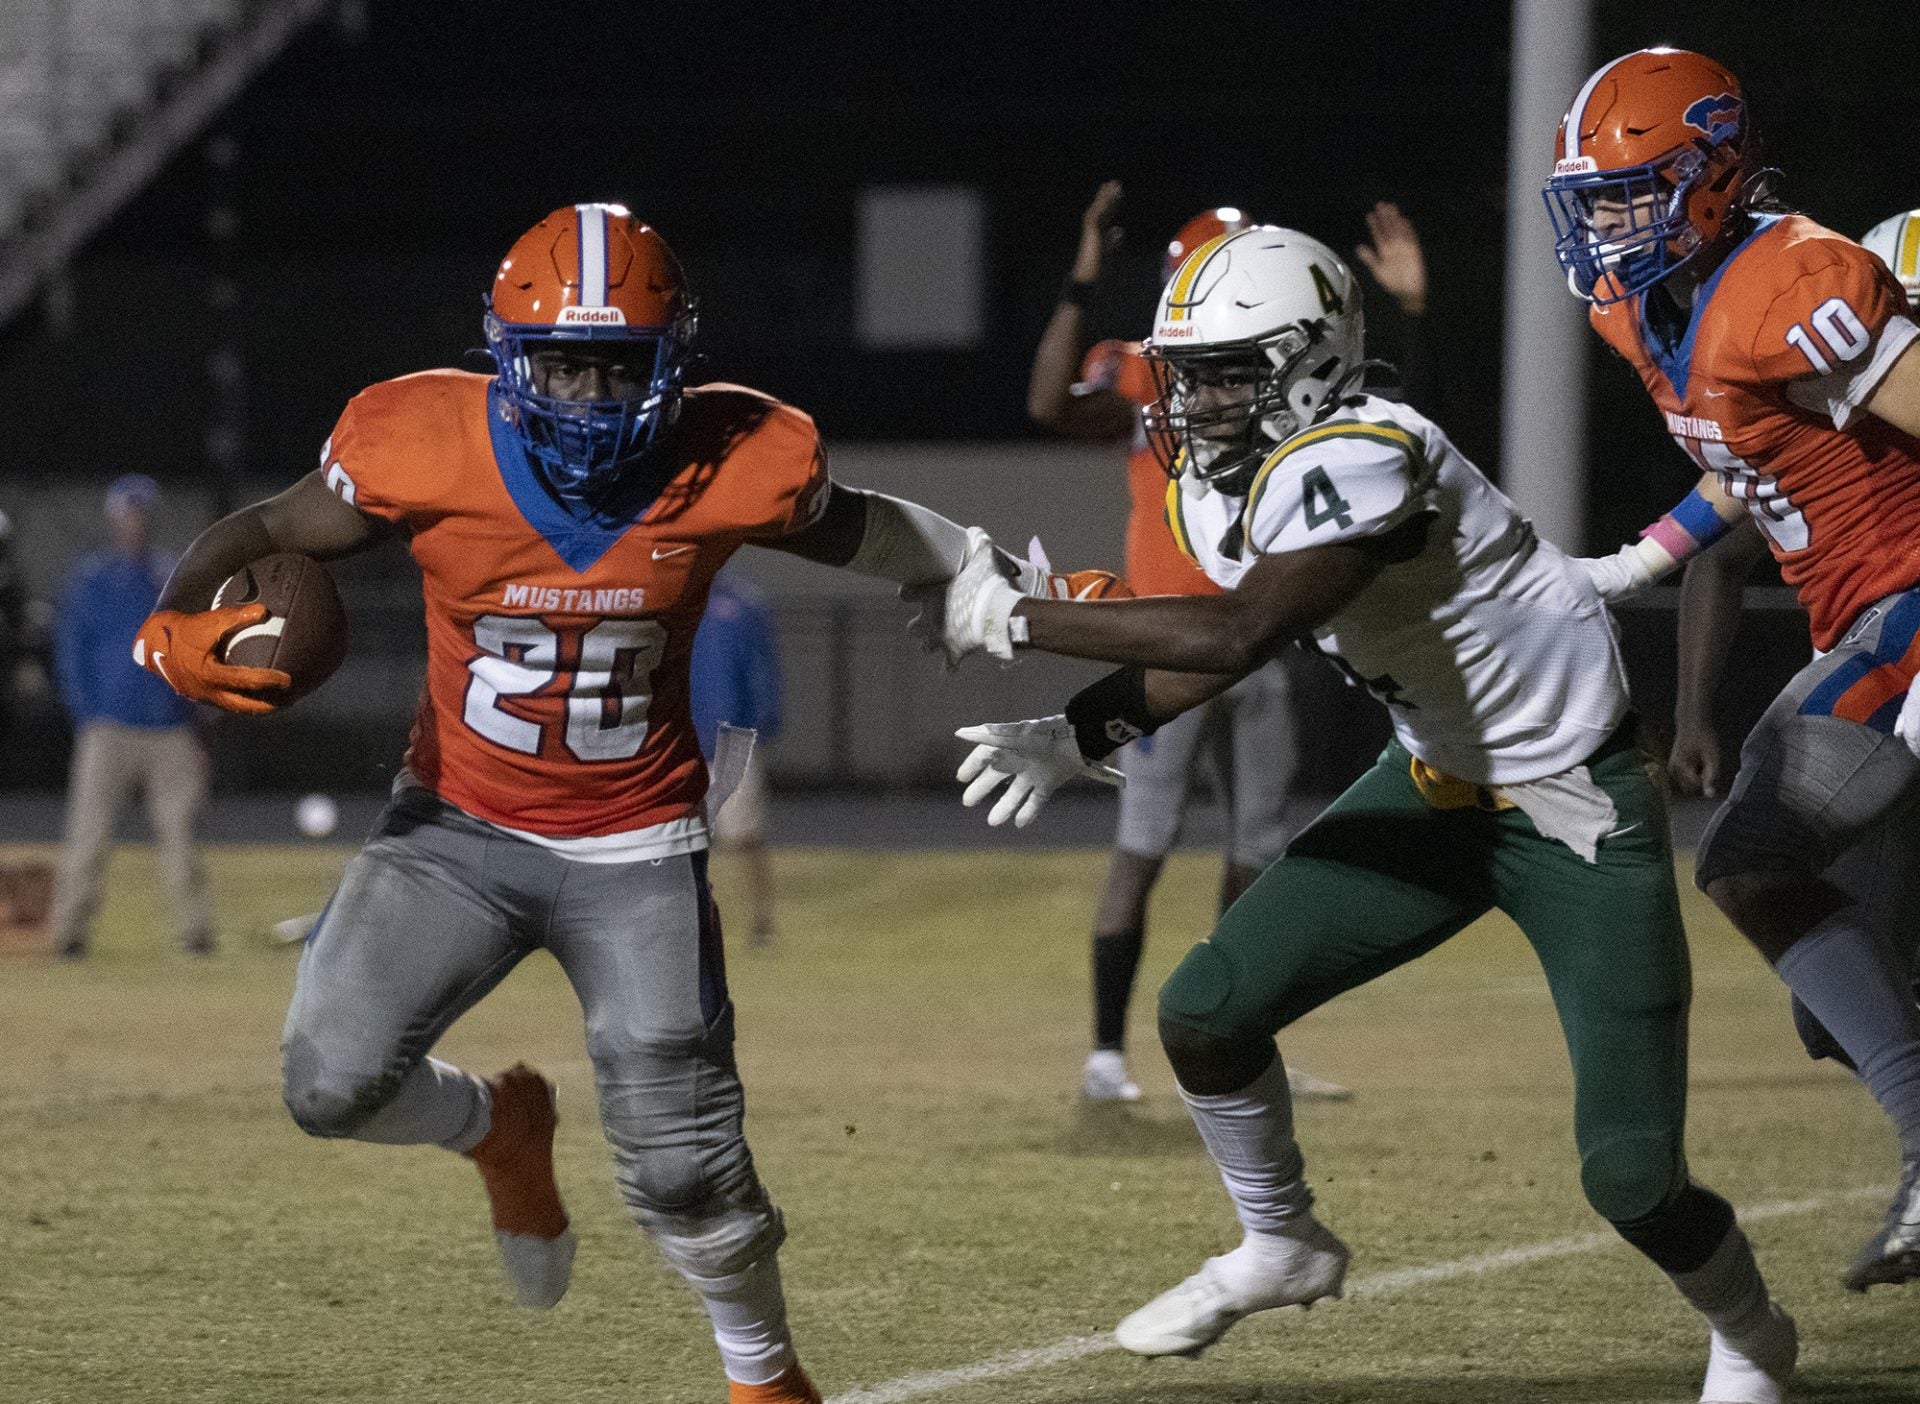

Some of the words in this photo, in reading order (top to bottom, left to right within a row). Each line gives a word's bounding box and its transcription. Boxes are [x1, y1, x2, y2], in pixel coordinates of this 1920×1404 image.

[1557, 160, 1589, 173] Riddell
[1308, 262, 1344, 315] 4
[565, 310, 619, 322] Riddell
[1158, 326, 1193, 338] Riddell
[1784, 296, 1870, 376] 10
[1666, 411, 1723, 440] MUSTANGS
[1302, 464, 1354, 531] 4
[502, 583, 645, 613] MUSTANGS
[462, 614, 669, 762] 20
